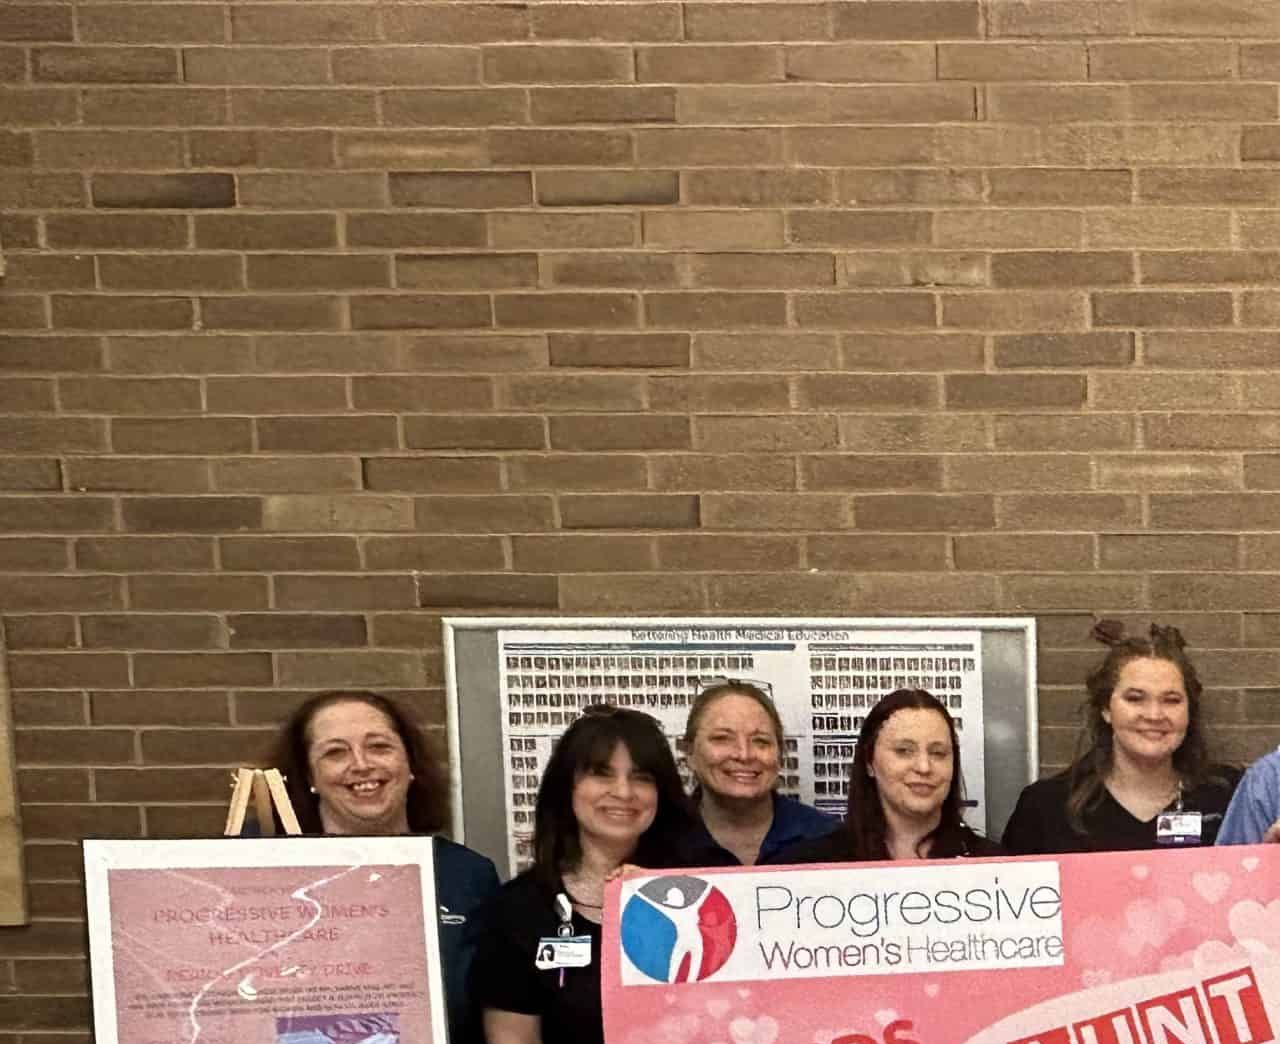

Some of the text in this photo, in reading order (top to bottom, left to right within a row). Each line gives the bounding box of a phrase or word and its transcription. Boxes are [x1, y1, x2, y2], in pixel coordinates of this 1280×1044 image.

[691, 629, 732, 641] Health
[735, 629, 785, 641] Medical
[789, 630, 850, 641] Education
[754, 876, 1063, 937] Progressive
[759, 931, 1063, 971] Women's Healthcare
